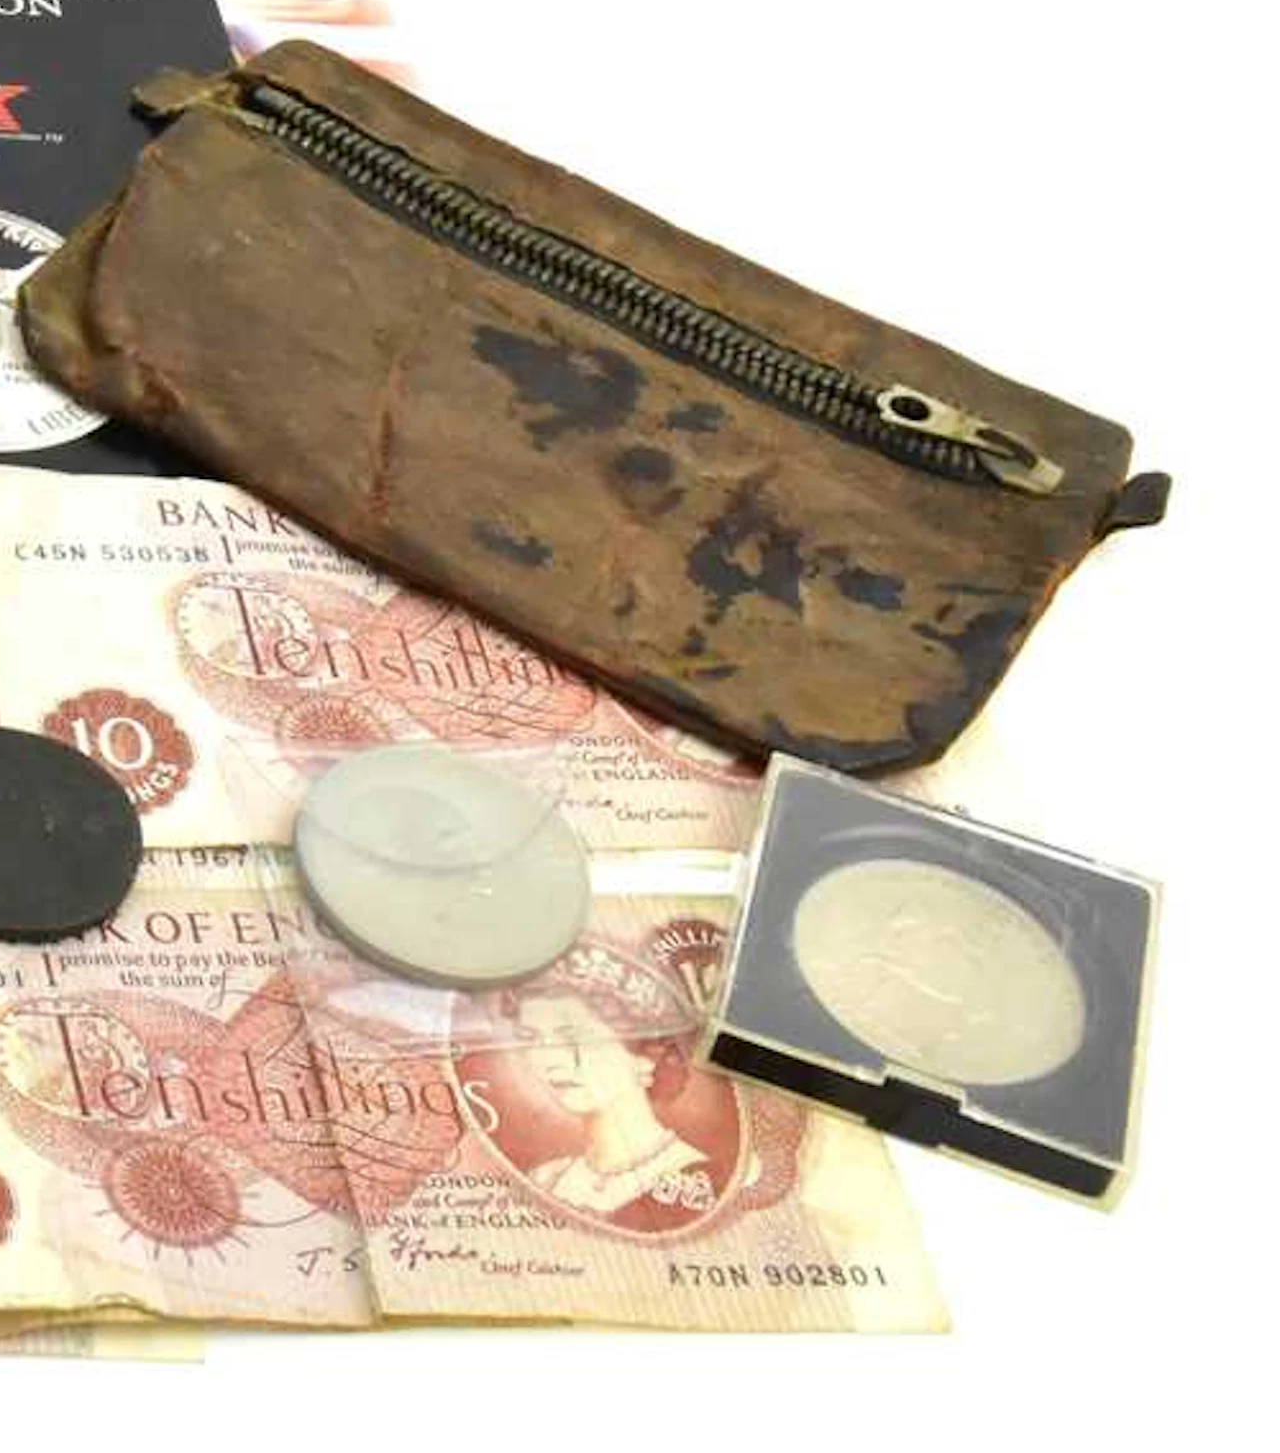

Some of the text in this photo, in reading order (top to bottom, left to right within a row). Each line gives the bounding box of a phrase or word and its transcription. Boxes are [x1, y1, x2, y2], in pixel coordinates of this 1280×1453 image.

[158, 498, 298, 538] BANK
[13, 542, 88, 563] C45N
[210, 584, 372, 681] Ten
[144, 909, 214, 945] OF
[58, 950, 146, 971] promise
[149, 952, 171, 967] to
[174, 952, 214, 974] pay
[217, 949, 250, 967] the
[118, 971, 205, 988] the sum
[18, 1010, 502, 1152] Ten shillings
[667, 1263, 889, 1289] A70N 902801
